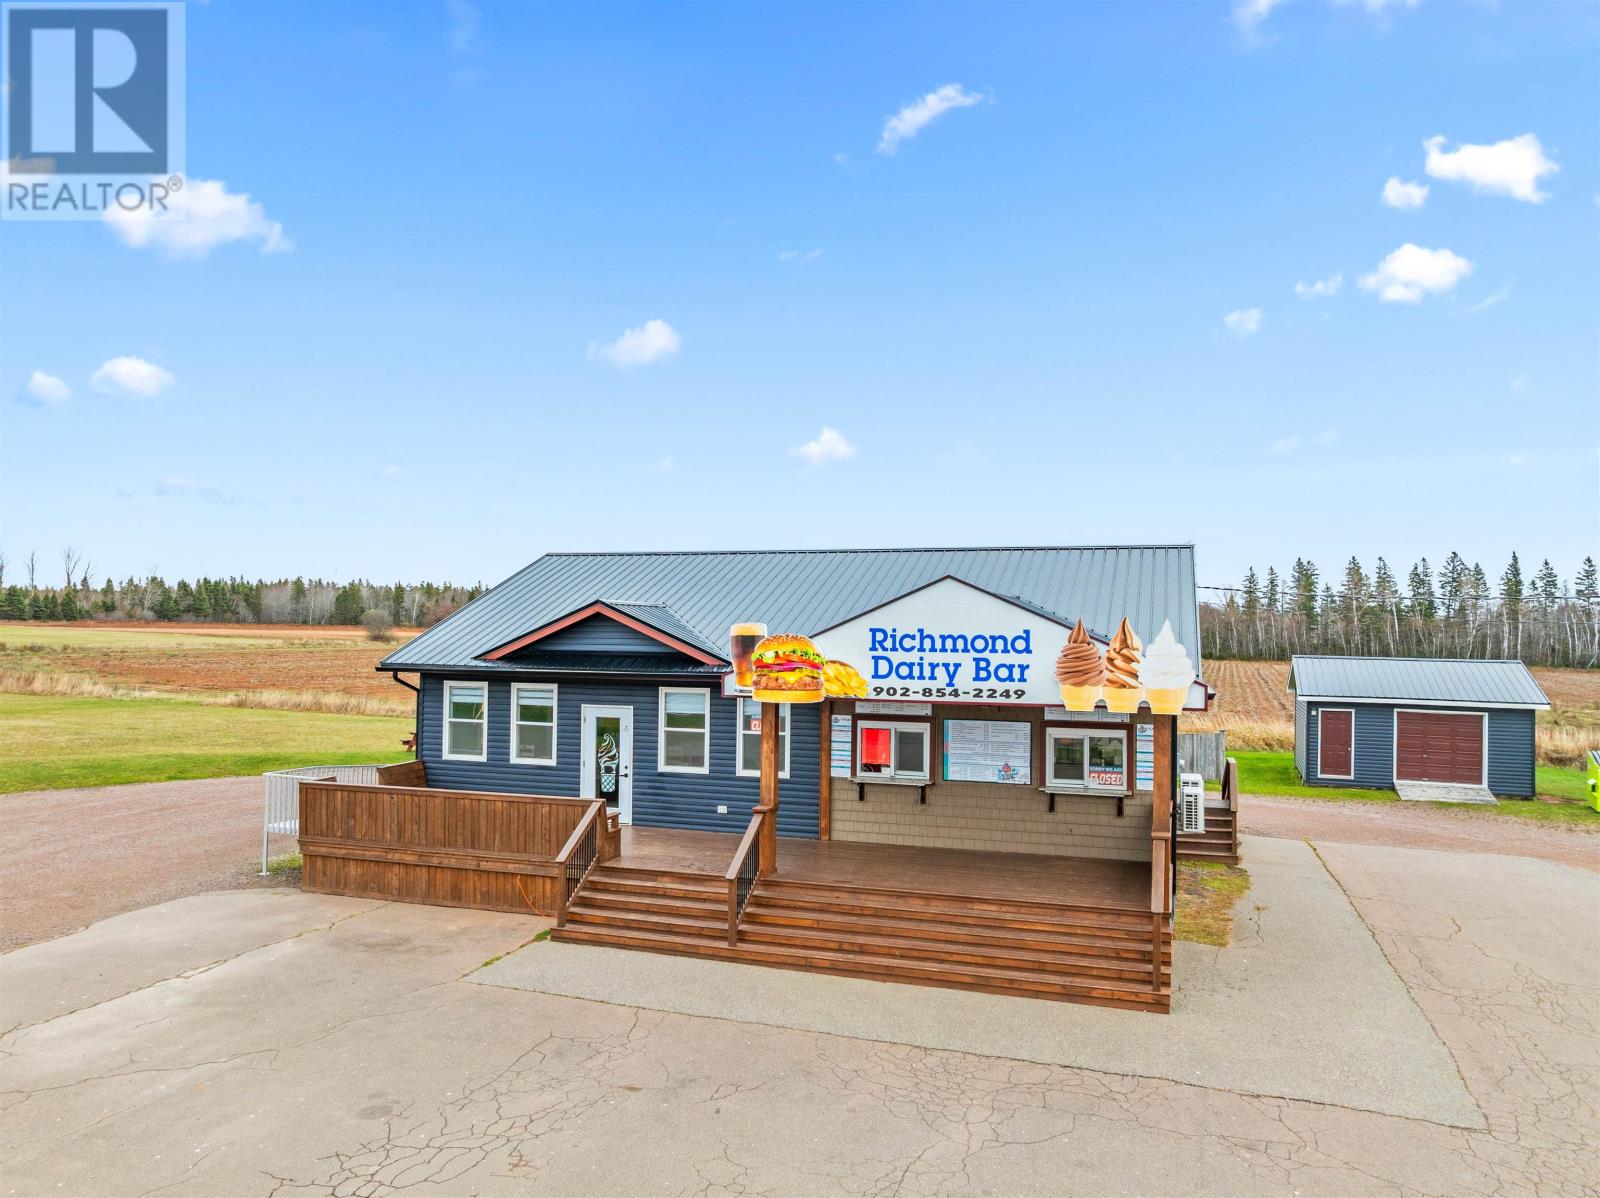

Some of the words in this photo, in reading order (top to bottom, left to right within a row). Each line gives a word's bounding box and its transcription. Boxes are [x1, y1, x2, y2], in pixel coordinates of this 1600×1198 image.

[869, 628, 1033, 654] Richmond
[871, 655, 962, 687] Dairy
[972, 657, 1030, 683] Bar
[872, 686, 1026, 699] 902-854-2249
[1089, 773, 1123, 785] CLOSED
